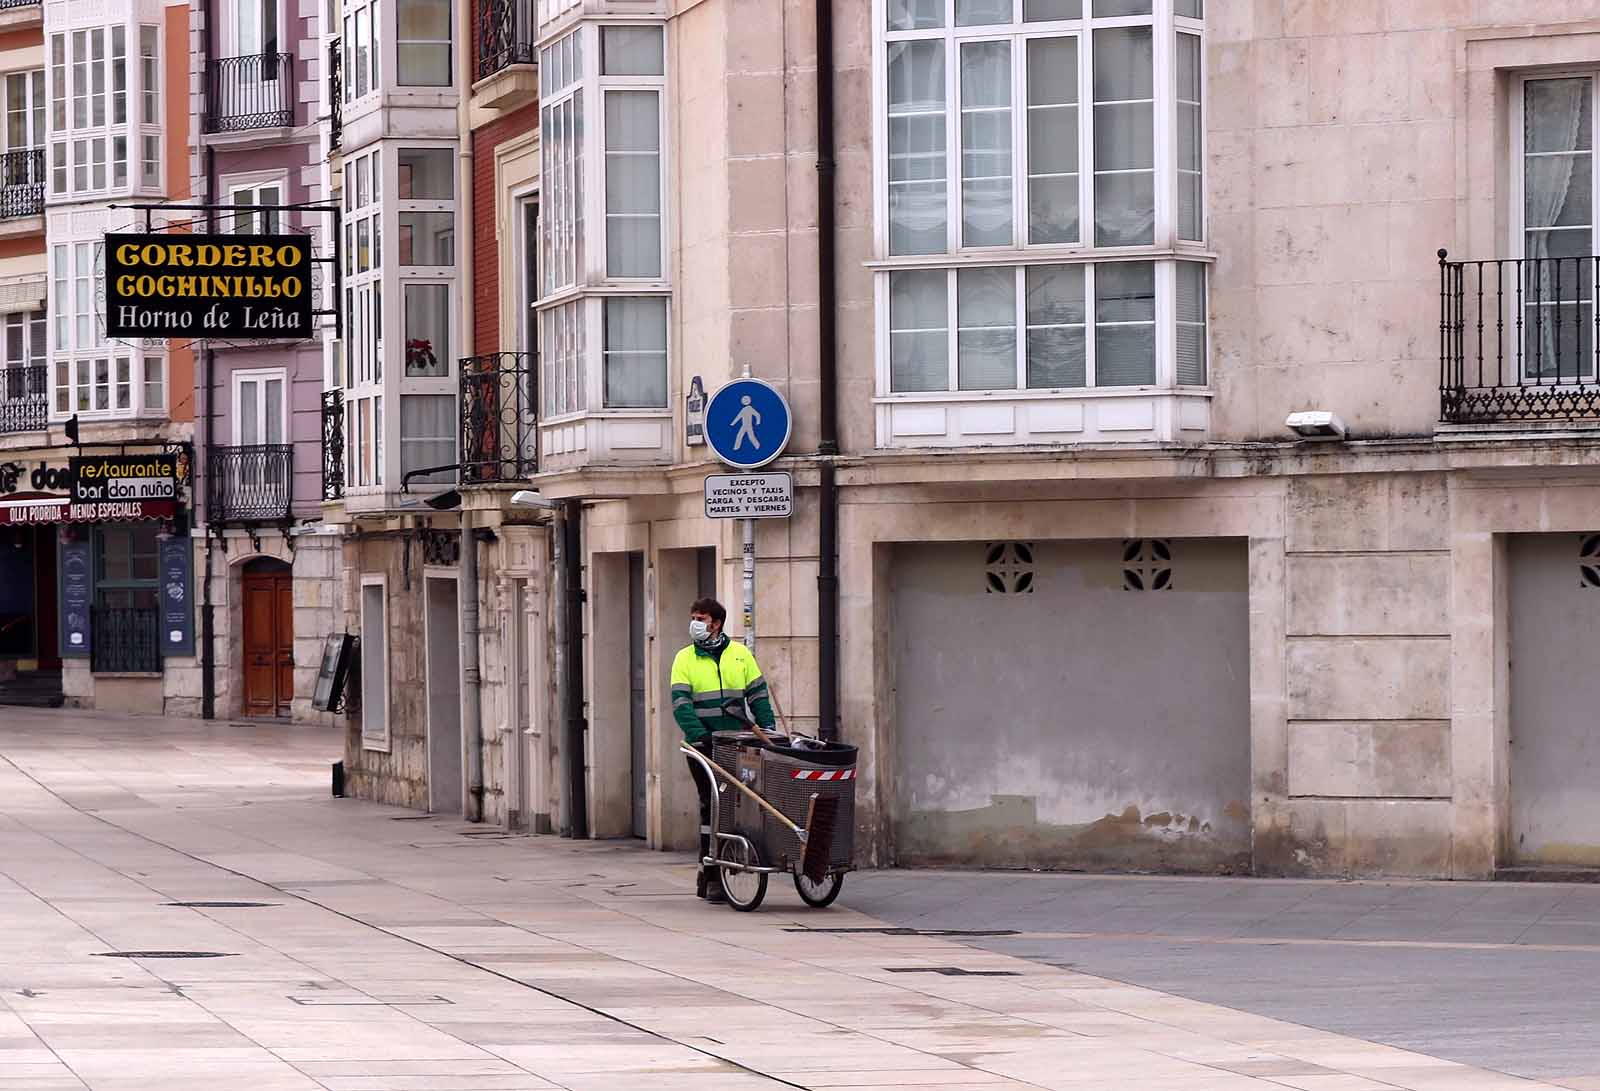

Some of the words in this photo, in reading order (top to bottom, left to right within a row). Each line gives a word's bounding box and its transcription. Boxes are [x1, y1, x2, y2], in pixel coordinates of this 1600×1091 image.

[116, 243, 302, 267] CORDERO
[116, 274, 302, 298] COCHINILLO
[117, 305, 193, 329] Horno
[203, 303, 232, 329] de
[243, 306, 301, 329] Leña
[79, 459, 172, 478] restaurante
[77, 481, 104, 499] bar
[109, 480, 136, 498] don
[141, 481, 173, 497] nuño
[712, 488, 748, 496] VECINOS
[9, 507, 28, 522] OLLA
[29, 505, 62, 521] PODRIDA
[70, 503, 97, 519] MENUS
[98, 501, 142, 518] ESPECIALES
[754, 504, 787, 512] VIERNES
